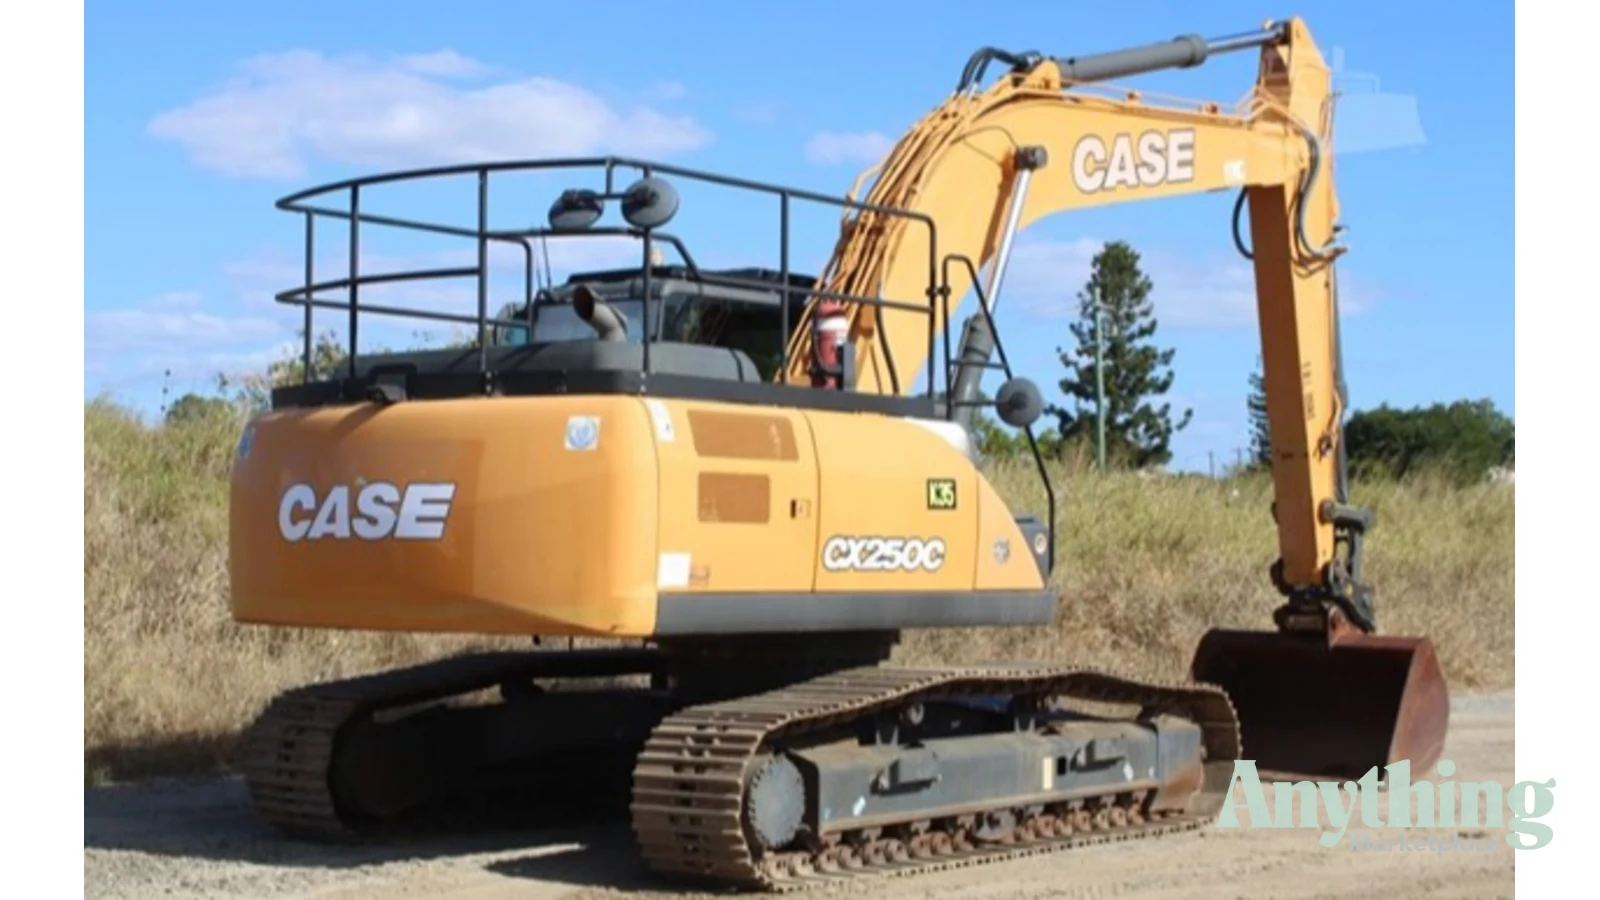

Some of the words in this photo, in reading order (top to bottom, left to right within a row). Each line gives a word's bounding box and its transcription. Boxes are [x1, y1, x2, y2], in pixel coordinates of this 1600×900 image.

[1073, 129, 1195, 192] CASE
[279, 482, 455, 542] CASE
[823, 535, 945, 571] CX250C
